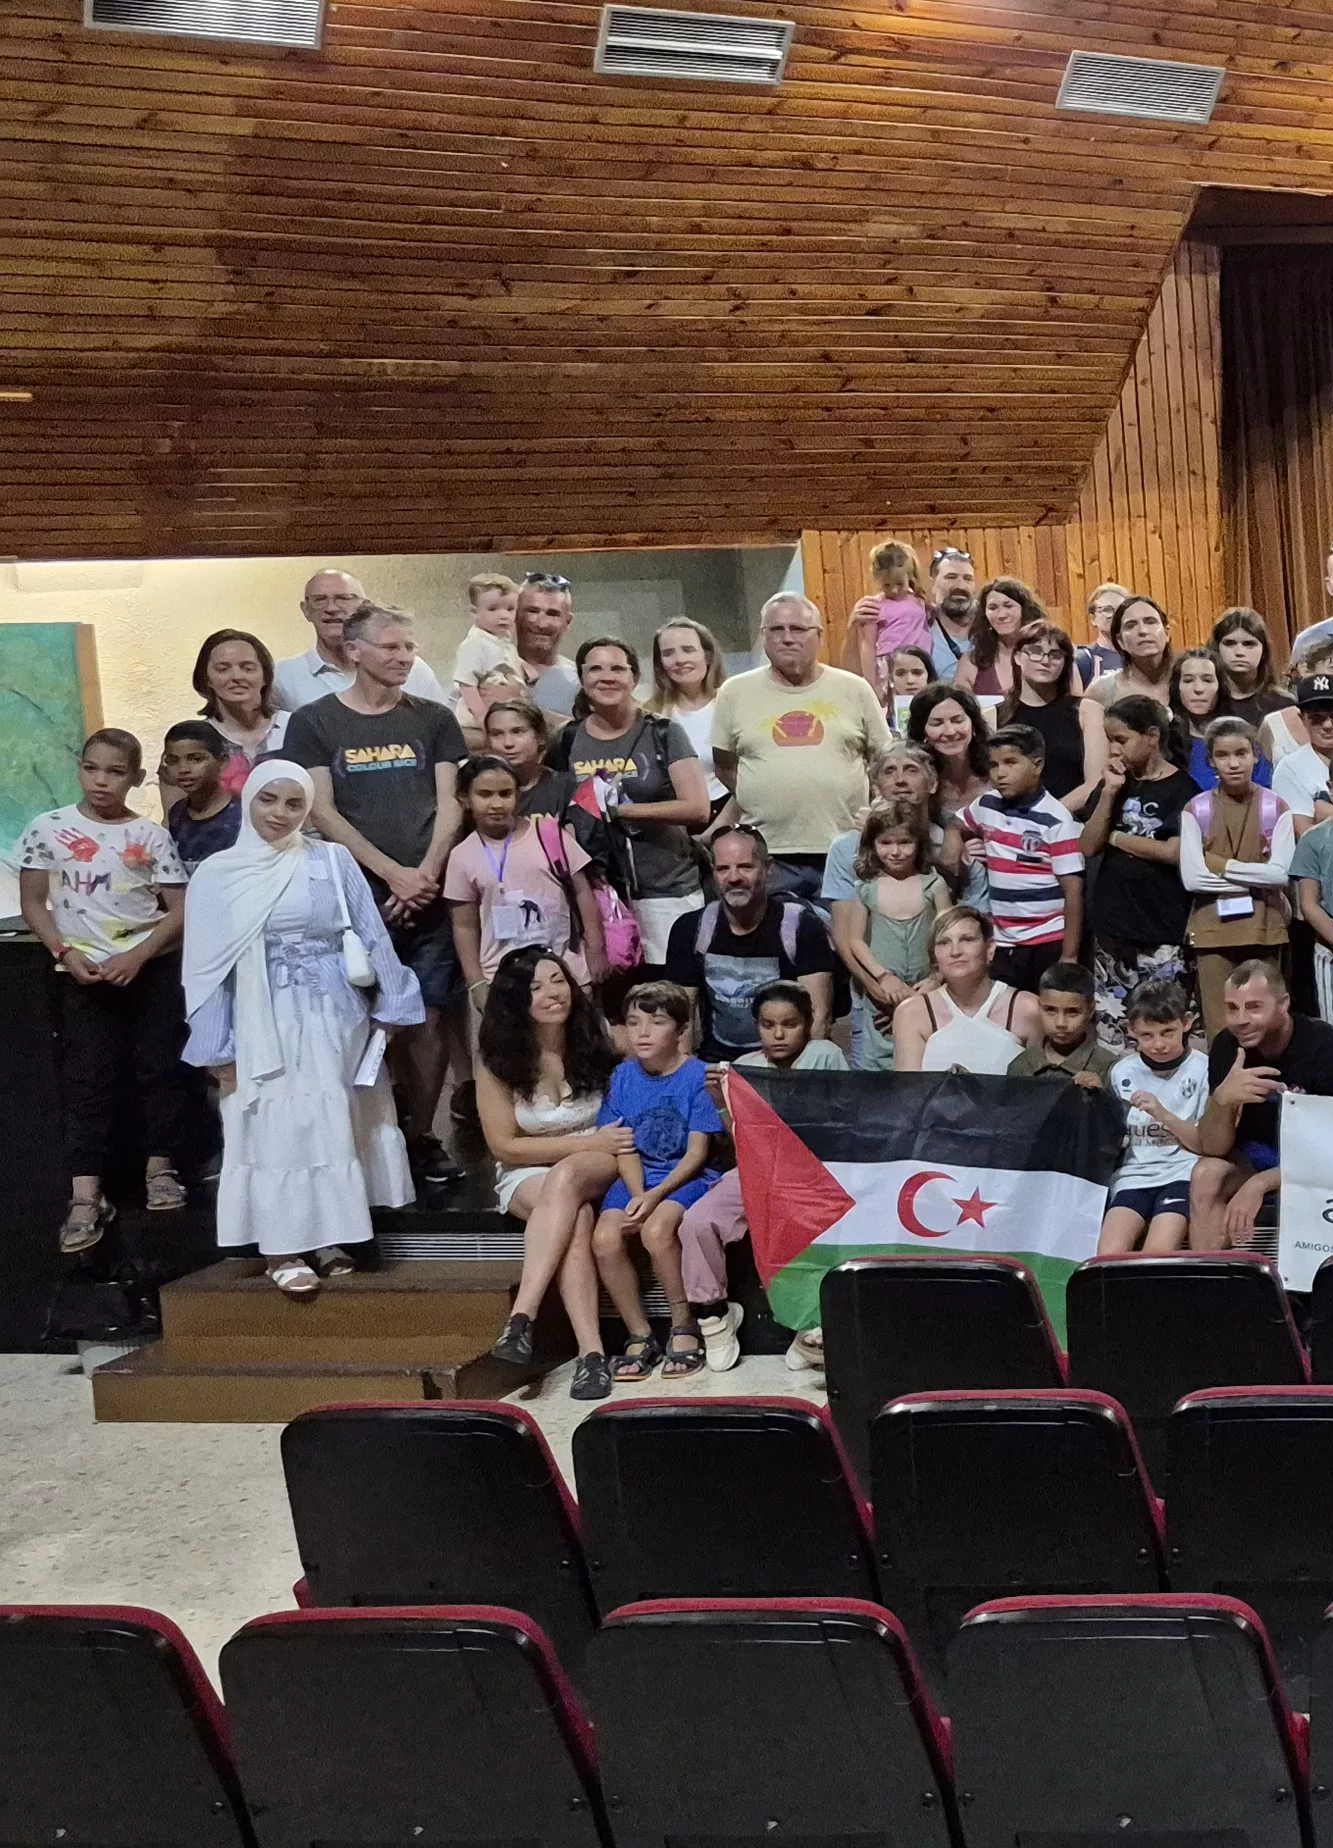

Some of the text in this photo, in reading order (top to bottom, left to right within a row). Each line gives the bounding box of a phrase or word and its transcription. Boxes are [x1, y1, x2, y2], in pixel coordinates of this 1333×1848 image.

[1313, 676, 1330, 690] NY
[345, 744, 417, 764] SAHARA
[574, 757, 638, 774] SAHARA
